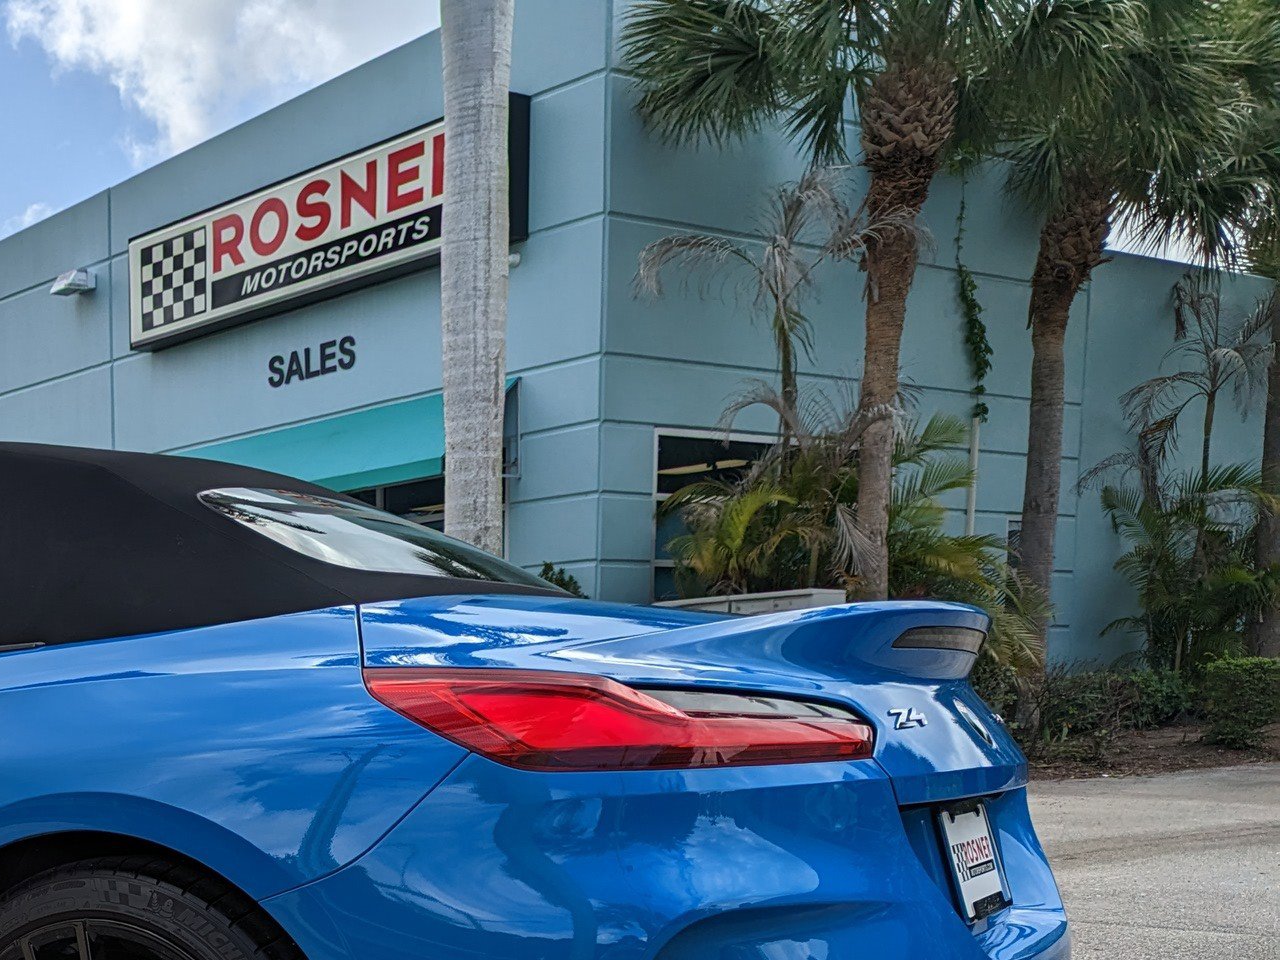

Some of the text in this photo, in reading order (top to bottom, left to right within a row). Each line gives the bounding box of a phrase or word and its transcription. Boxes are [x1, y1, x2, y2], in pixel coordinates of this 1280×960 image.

[241, 215, 431, 296] MOTORSPORTS
[268, 335, 357, 388] SALES
[887, 707, 928, 730] Z4
